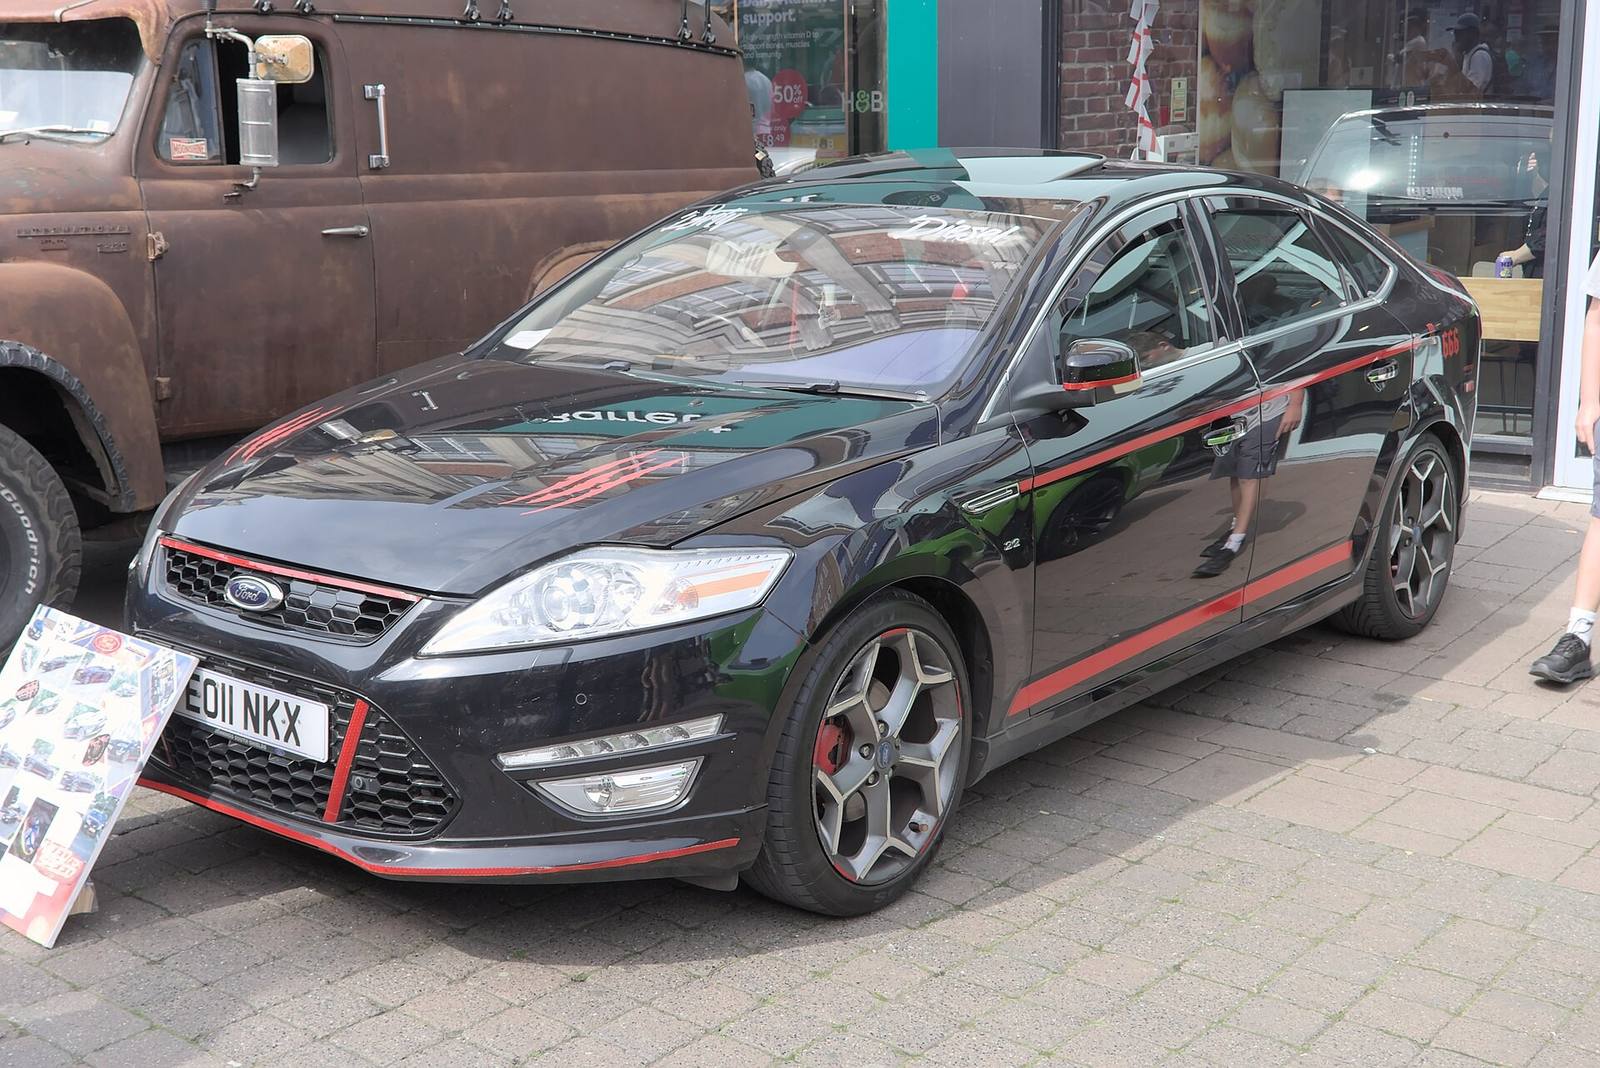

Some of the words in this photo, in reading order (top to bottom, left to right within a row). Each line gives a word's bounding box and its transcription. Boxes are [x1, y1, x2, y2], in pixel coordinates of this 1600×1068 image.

[743, 9, 796, 26] support.
[841, 90, 883, 113] H&B
[888, 214, 1020, 245] Diesel
[0, 483, 40, 595] Goodrich
[235, 583, 262, 602] Ford
[243, 689, 301, 747] NKX
